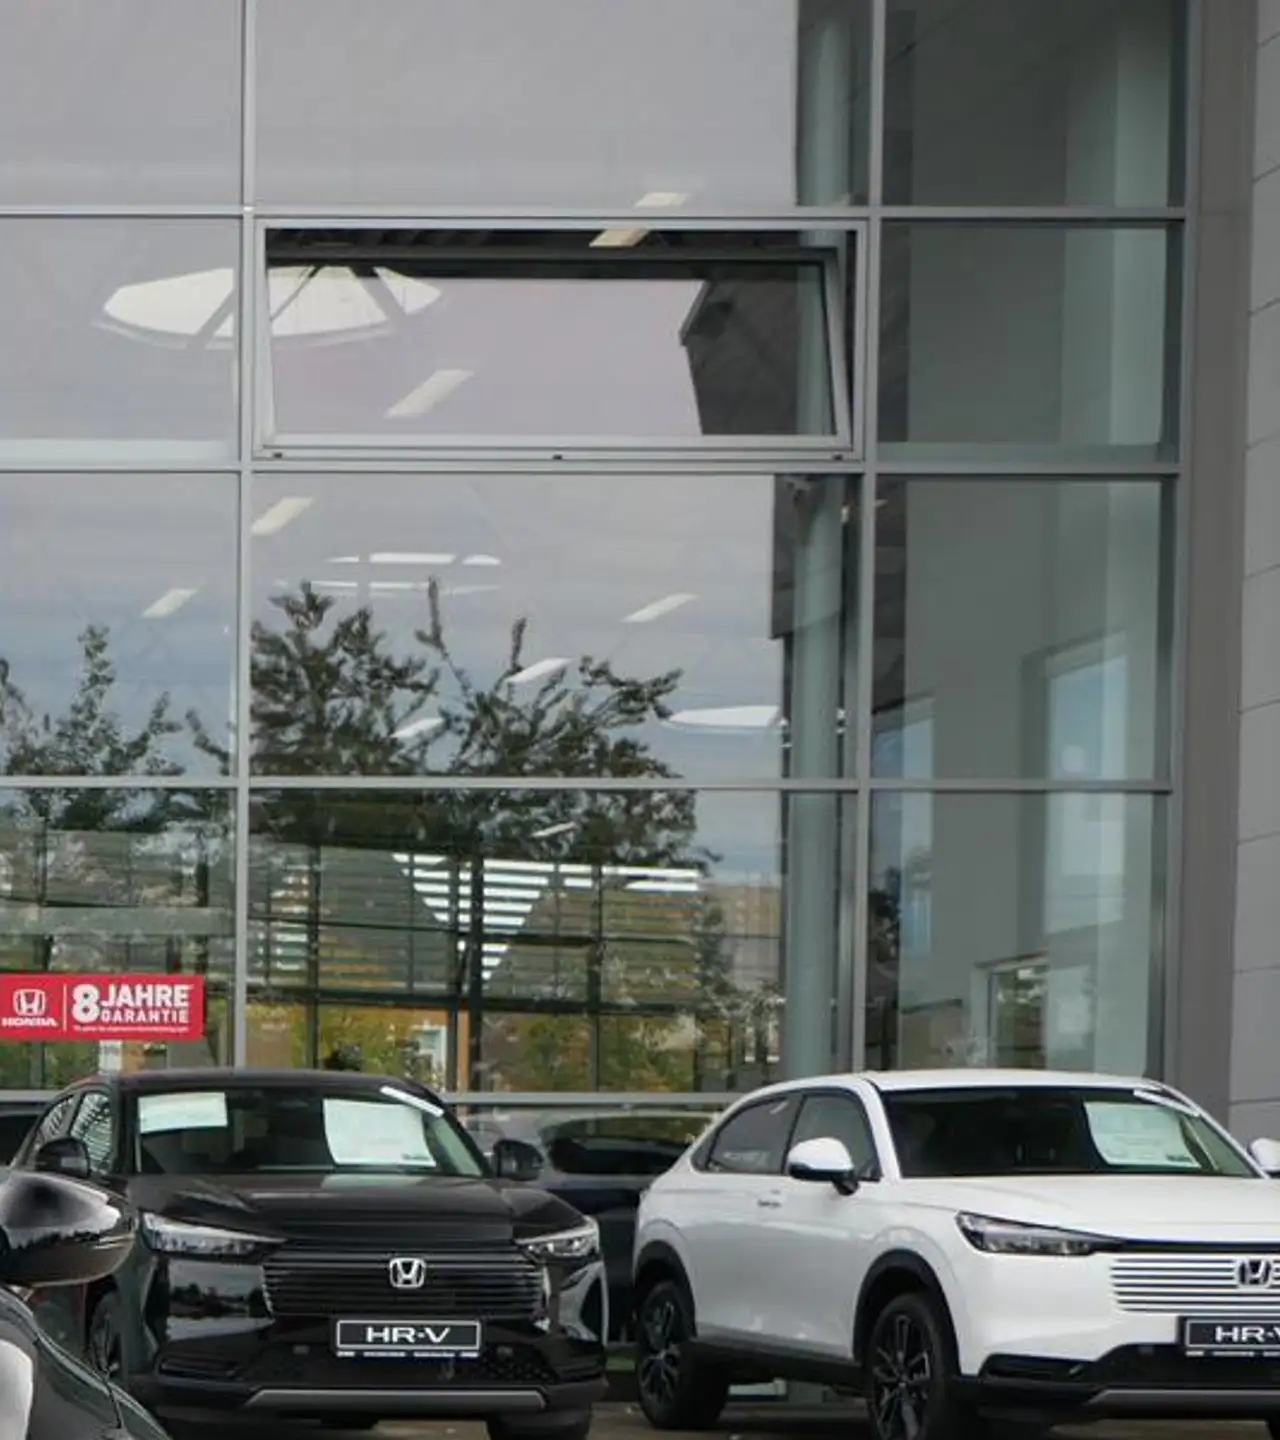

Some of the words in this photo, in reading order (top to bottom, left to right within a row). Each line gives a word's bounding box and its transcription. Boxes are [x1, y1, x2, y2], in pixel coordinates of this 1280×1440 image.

[72, 983, 100, 1023] 8
[1, 1017, 58, 1027] HONDA
[101, 1008, 189, 1023] GARANTIE
[366, 1327, 450, 1342] HR-V
[1215, 1326, 1280, 1342] HR-
